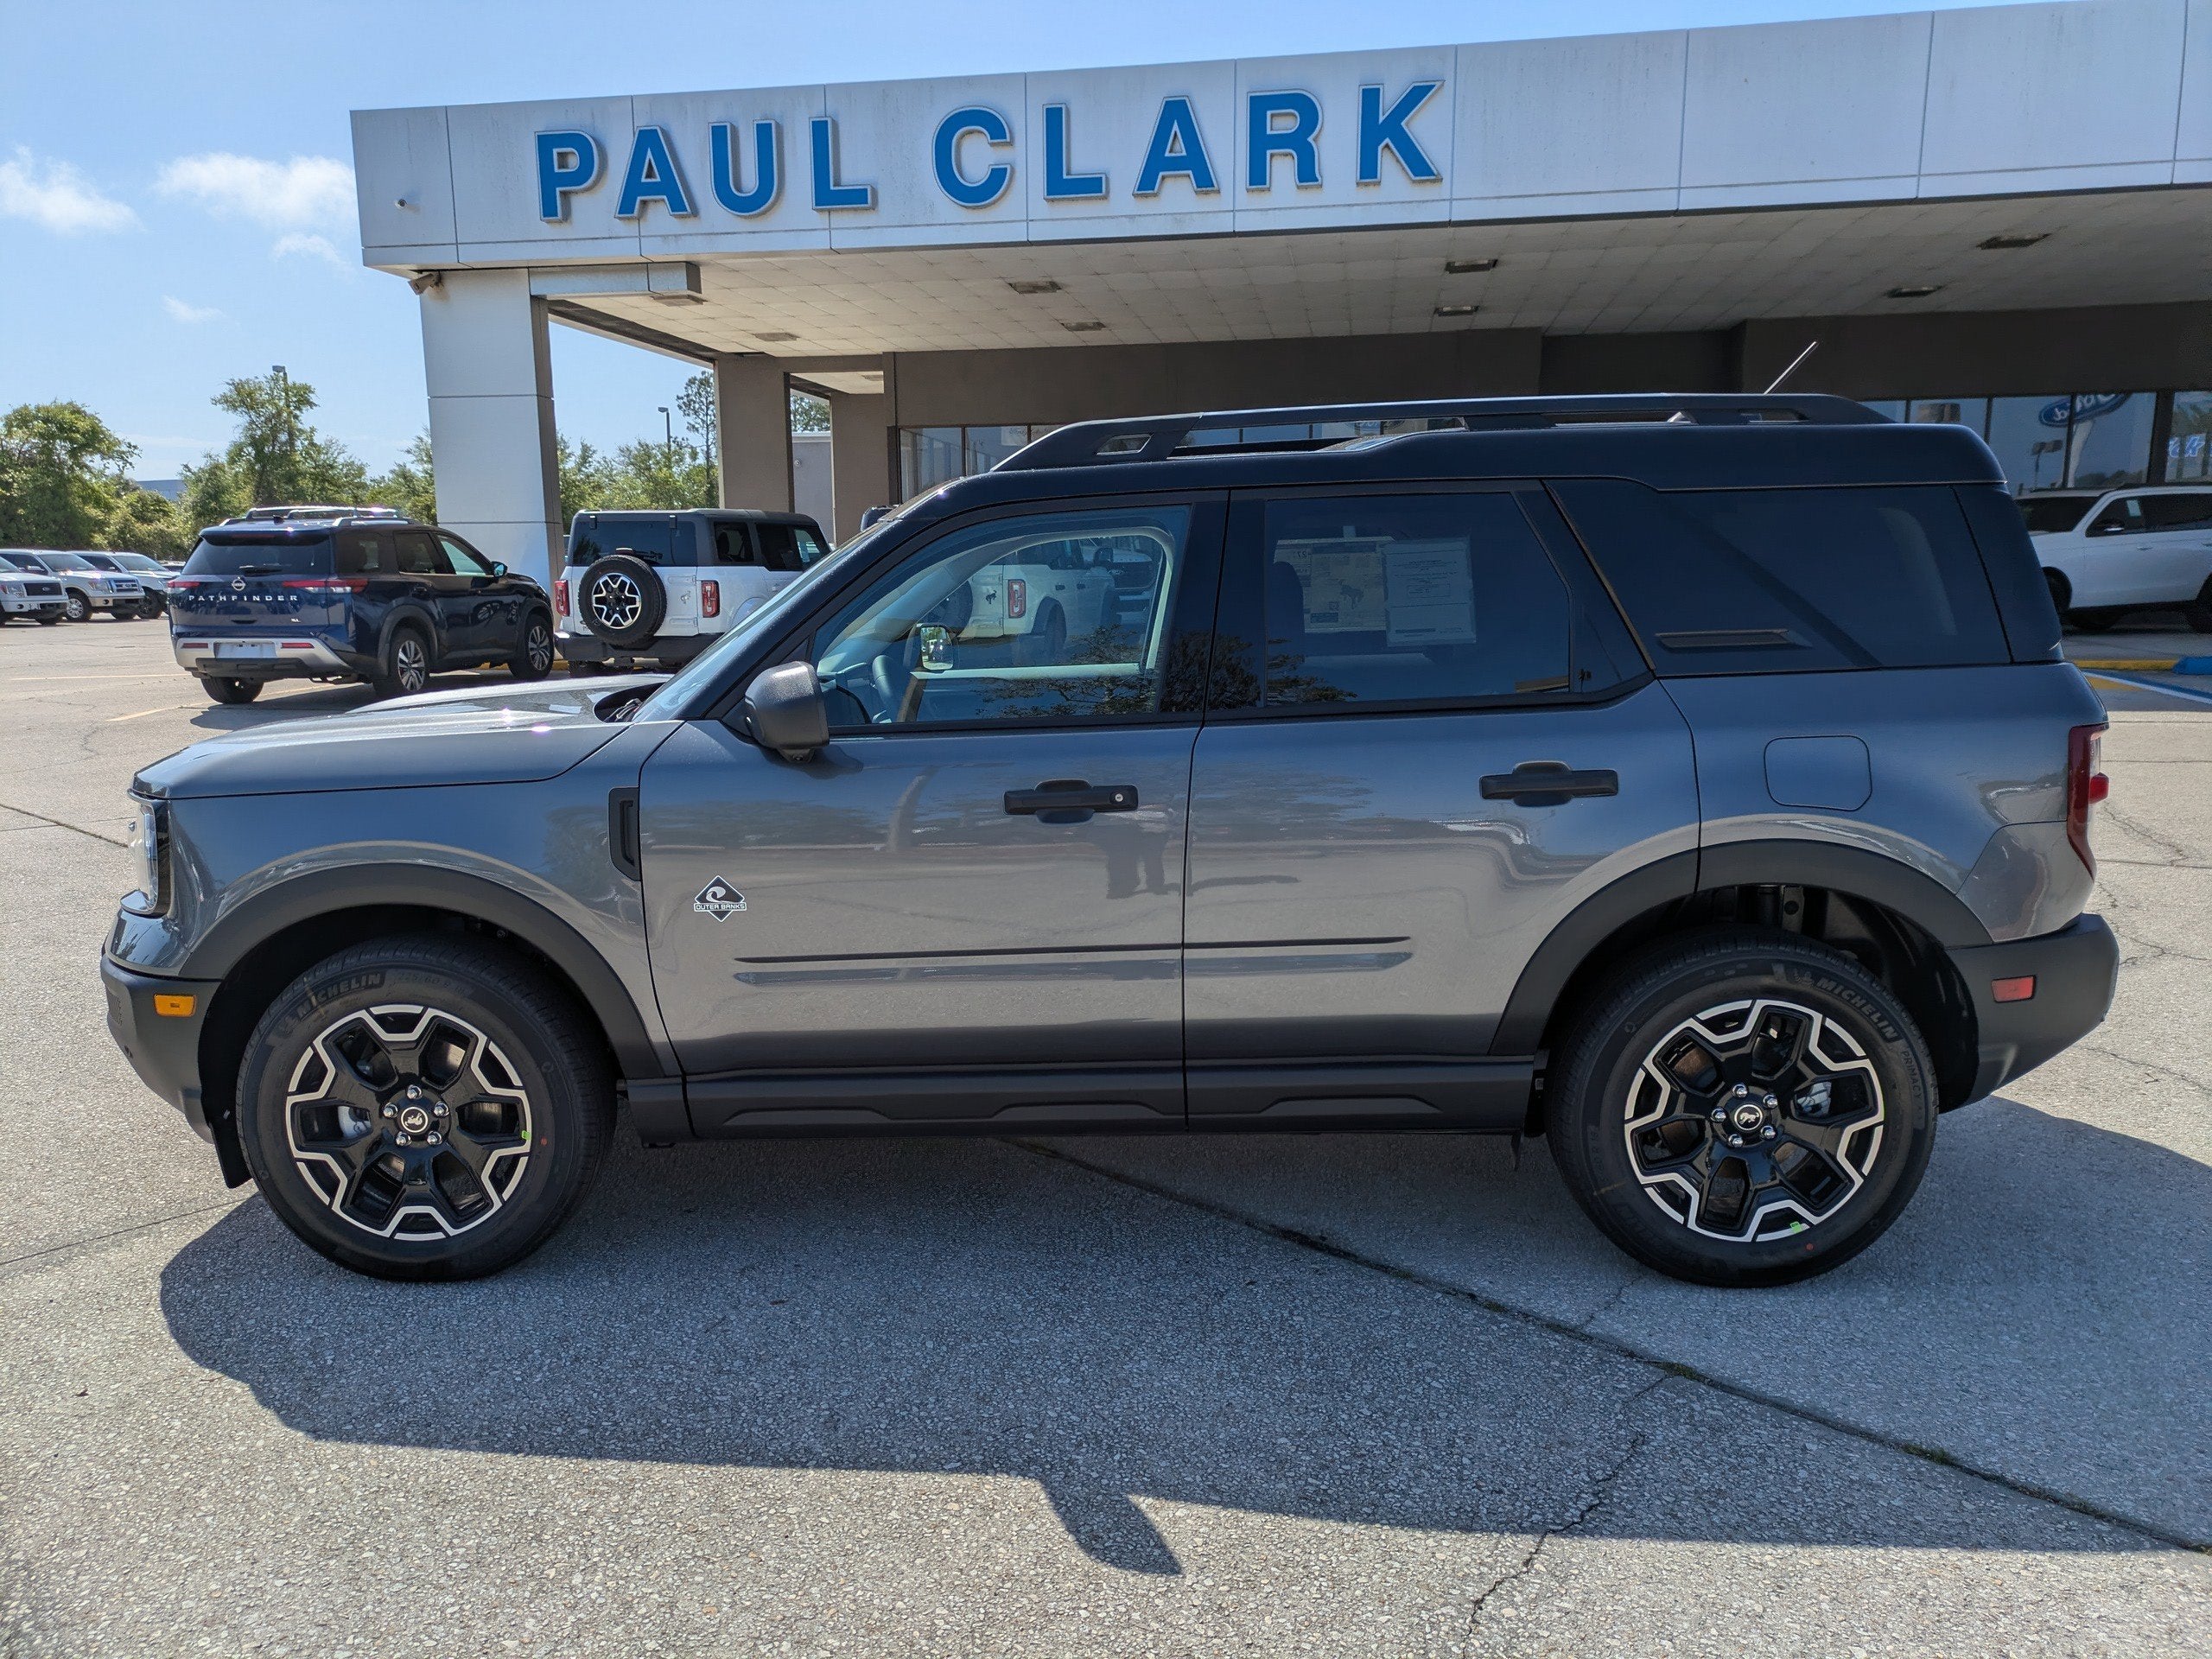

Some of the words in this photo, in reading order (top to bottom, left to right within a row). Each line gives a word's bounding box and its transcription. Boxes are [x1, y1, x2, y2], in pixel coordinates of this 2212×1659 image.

[534, 116, 876, 223] PAUL
[931, 79, 1446, 209] CLARK
[296, 973, 381, 1020] MICHELIN
[1815, 977, 1899, 1042] MICHELIN
[1900, 1051, 1923, 1101] PRIMACY
